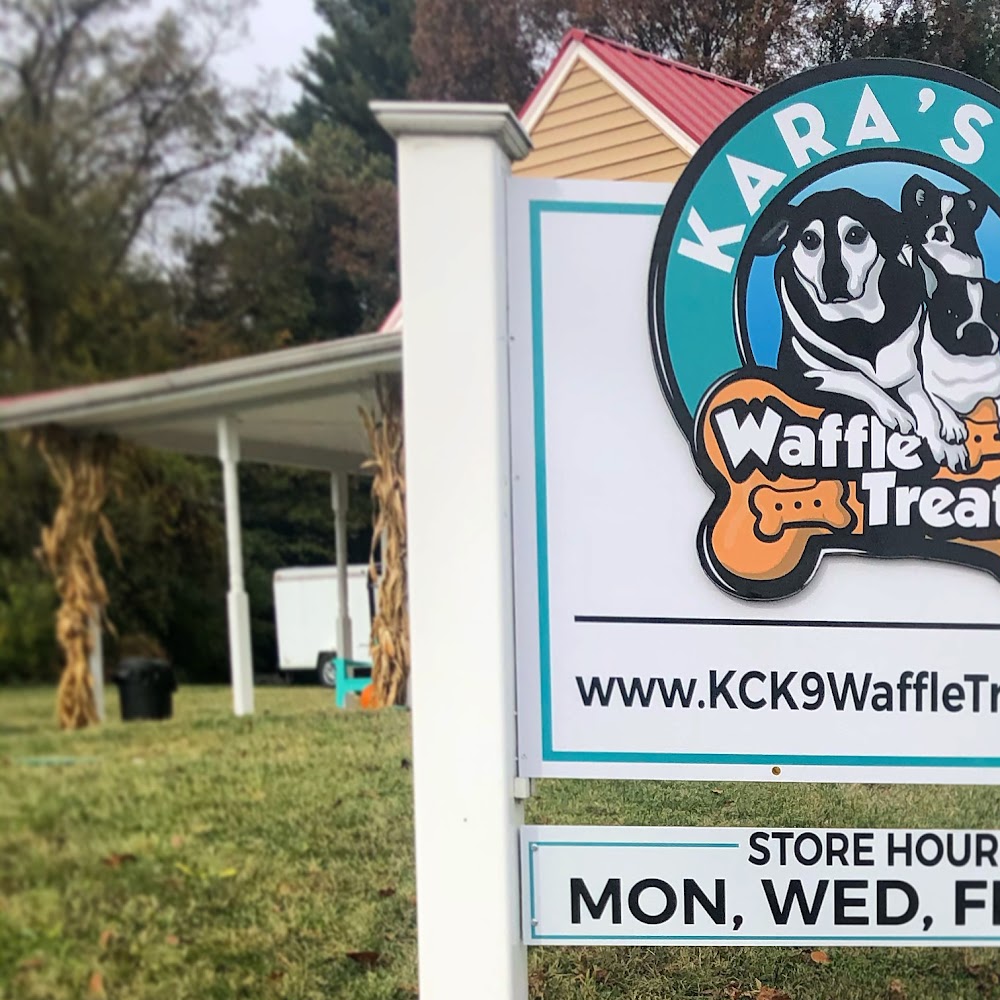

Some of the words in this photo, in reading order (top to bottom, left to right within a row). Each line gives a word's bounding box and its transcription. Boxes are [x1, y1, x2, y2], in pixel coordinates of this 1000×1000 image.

[677, 83, 994, 274] KARA'S
[715, 407, 923, 471] Waffle
[747, 831, 875, 867] STORE
[570, 877, 744, 932] MON,
[761, 879, 934, 931] WED,
